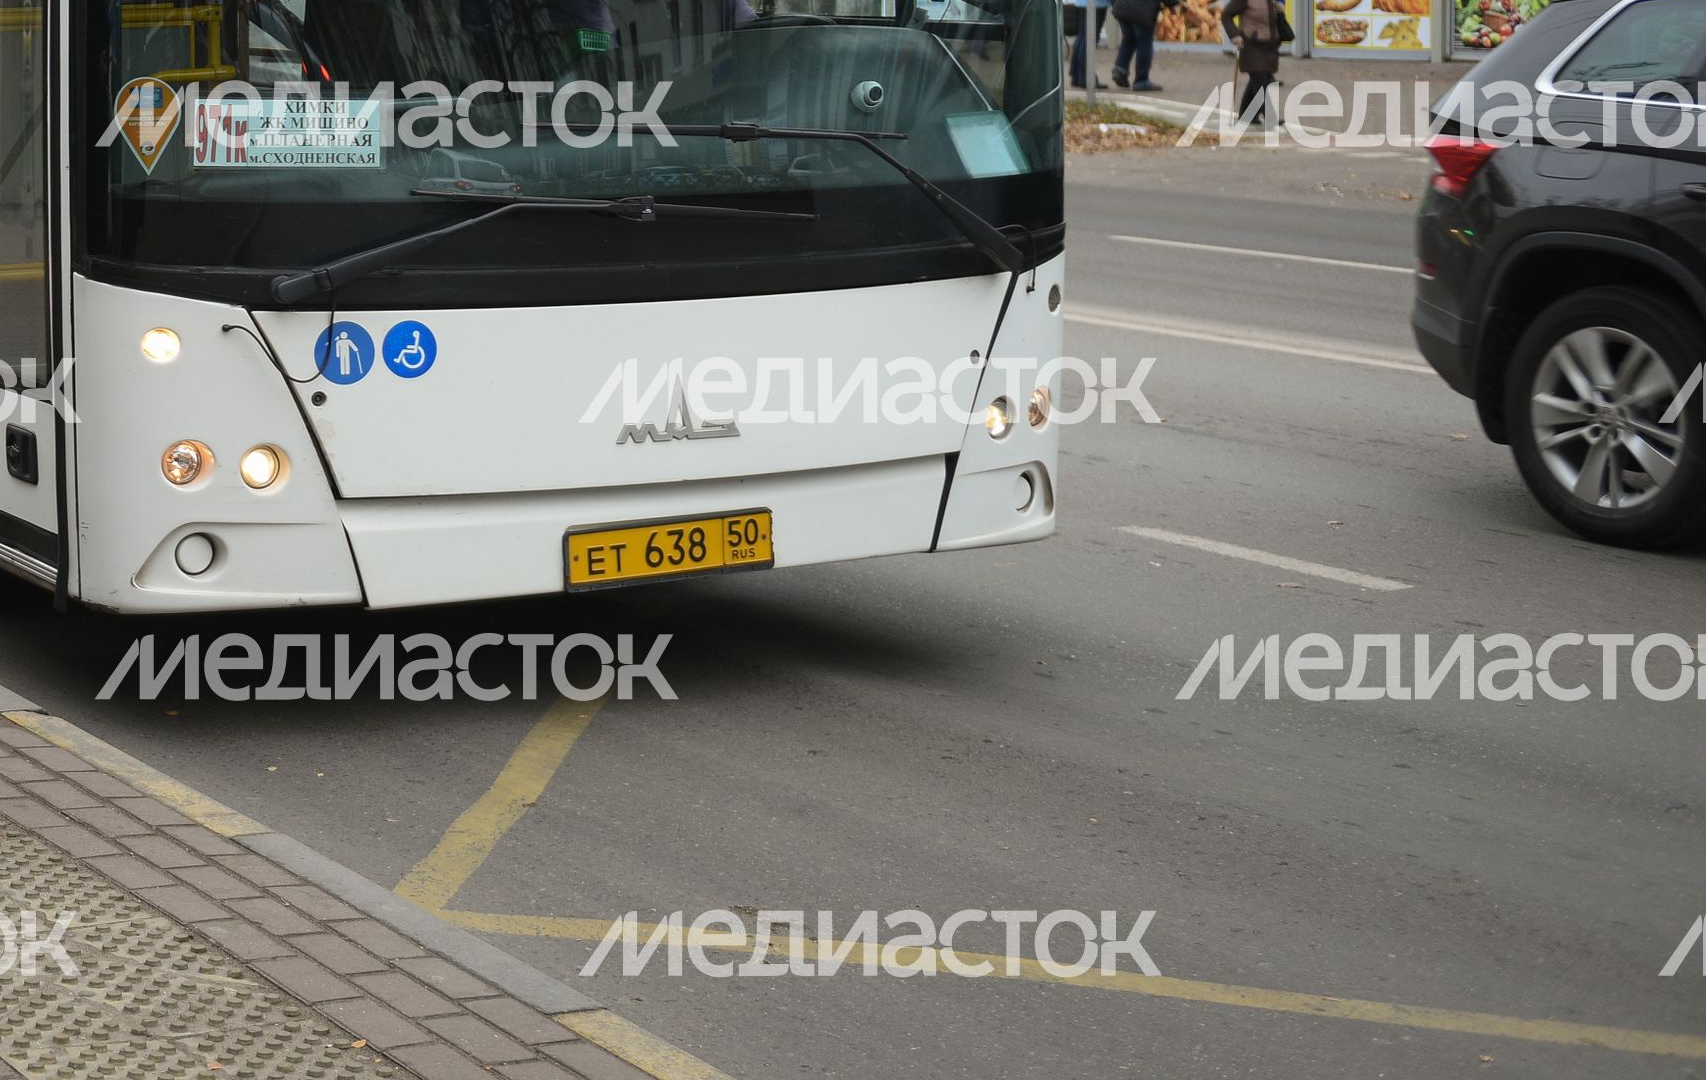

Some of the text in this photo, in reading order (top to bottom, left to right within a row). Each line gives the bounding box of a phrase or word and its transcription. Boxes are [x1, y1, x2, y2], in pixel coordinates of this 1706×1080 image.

[284, 101, 346, 114] ХИМКИ
[259, 117, 369, 130] ЖК МИШИНО
[249, 152, 376, 165] м.СХОДНЕНСКАЯ
[587, 518, 759, 575] ЕТ 638 50
[732, 547, 756, 560] RUS
